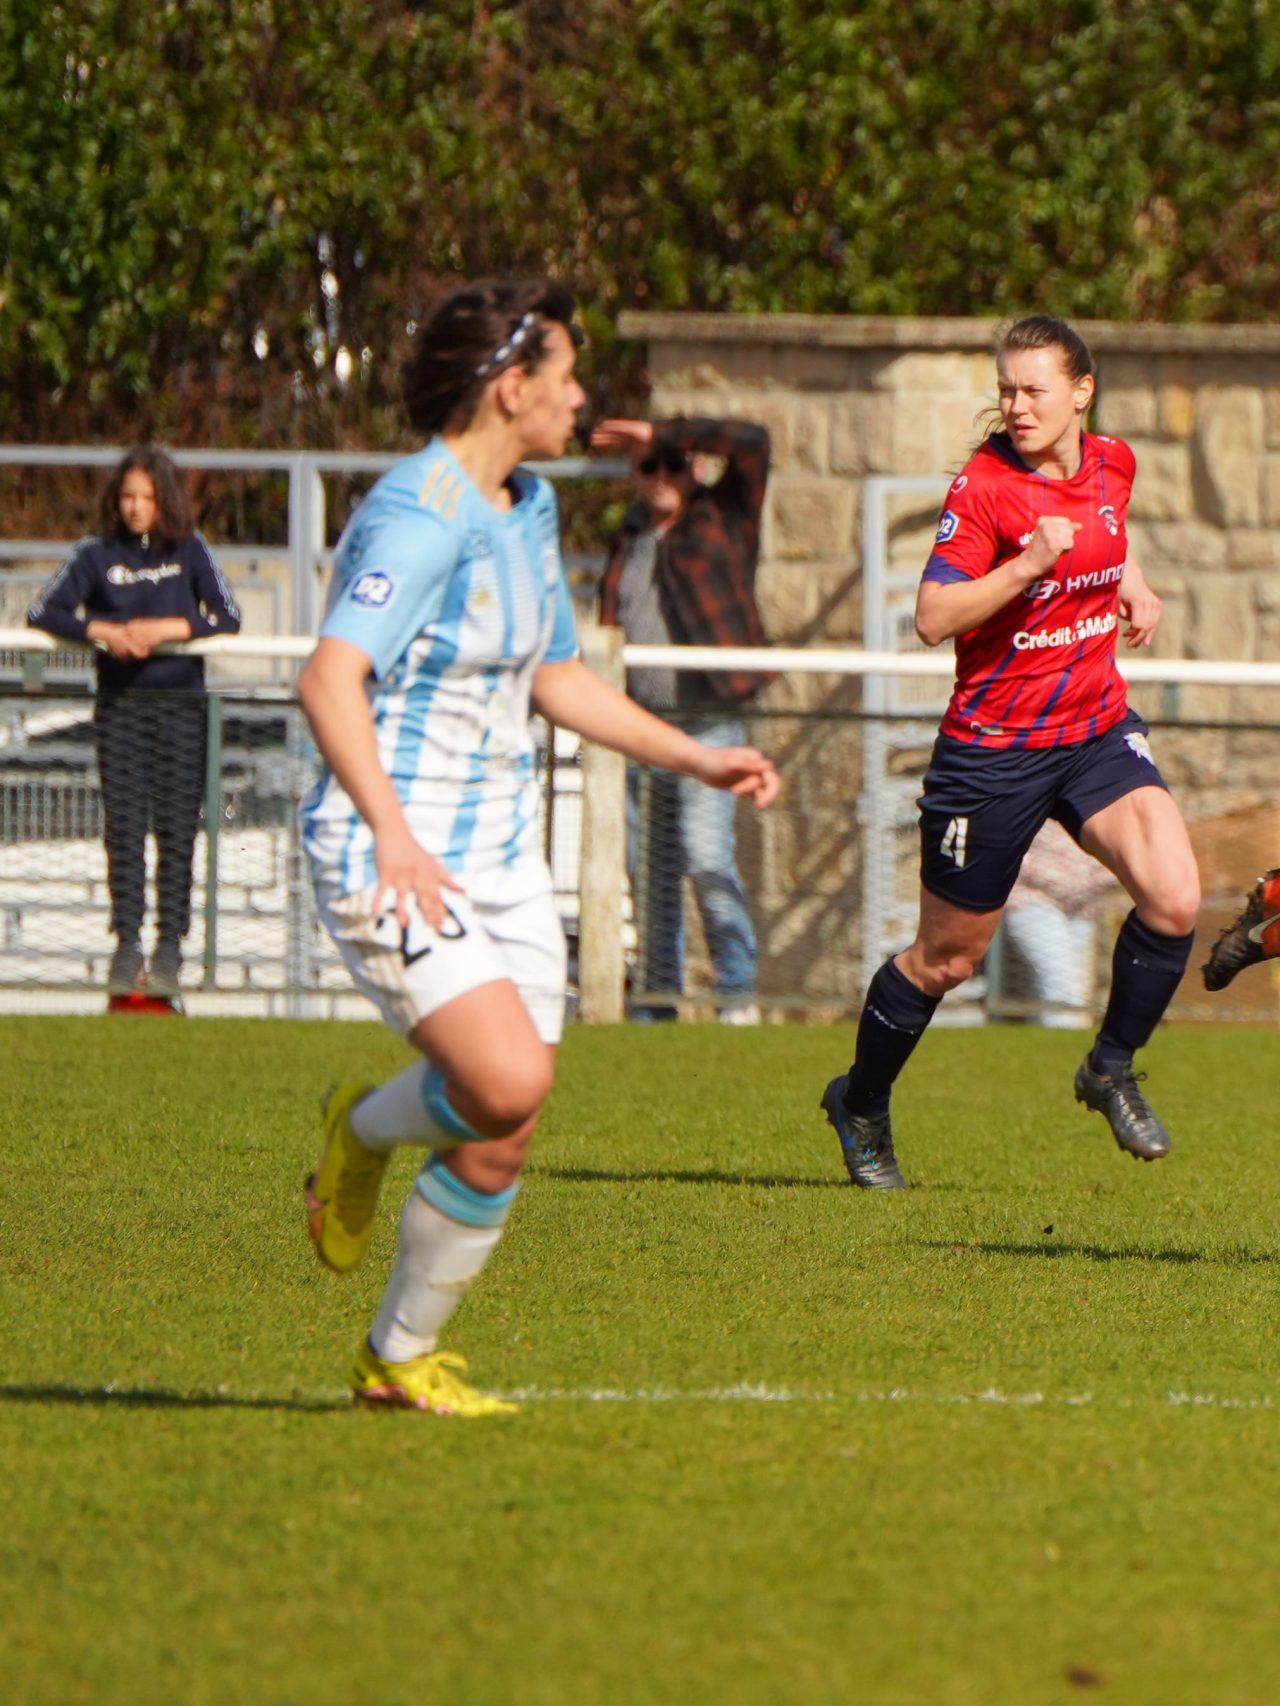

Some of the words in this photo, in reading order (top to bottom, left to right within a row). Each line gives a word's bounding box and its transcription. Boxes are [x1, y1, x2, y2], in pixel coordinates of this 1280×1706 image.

[1066, 562, 1125, 592] HYUND
[1013, 629, 1073, 650] Crédit
[940, 816, 969, 868] 4
